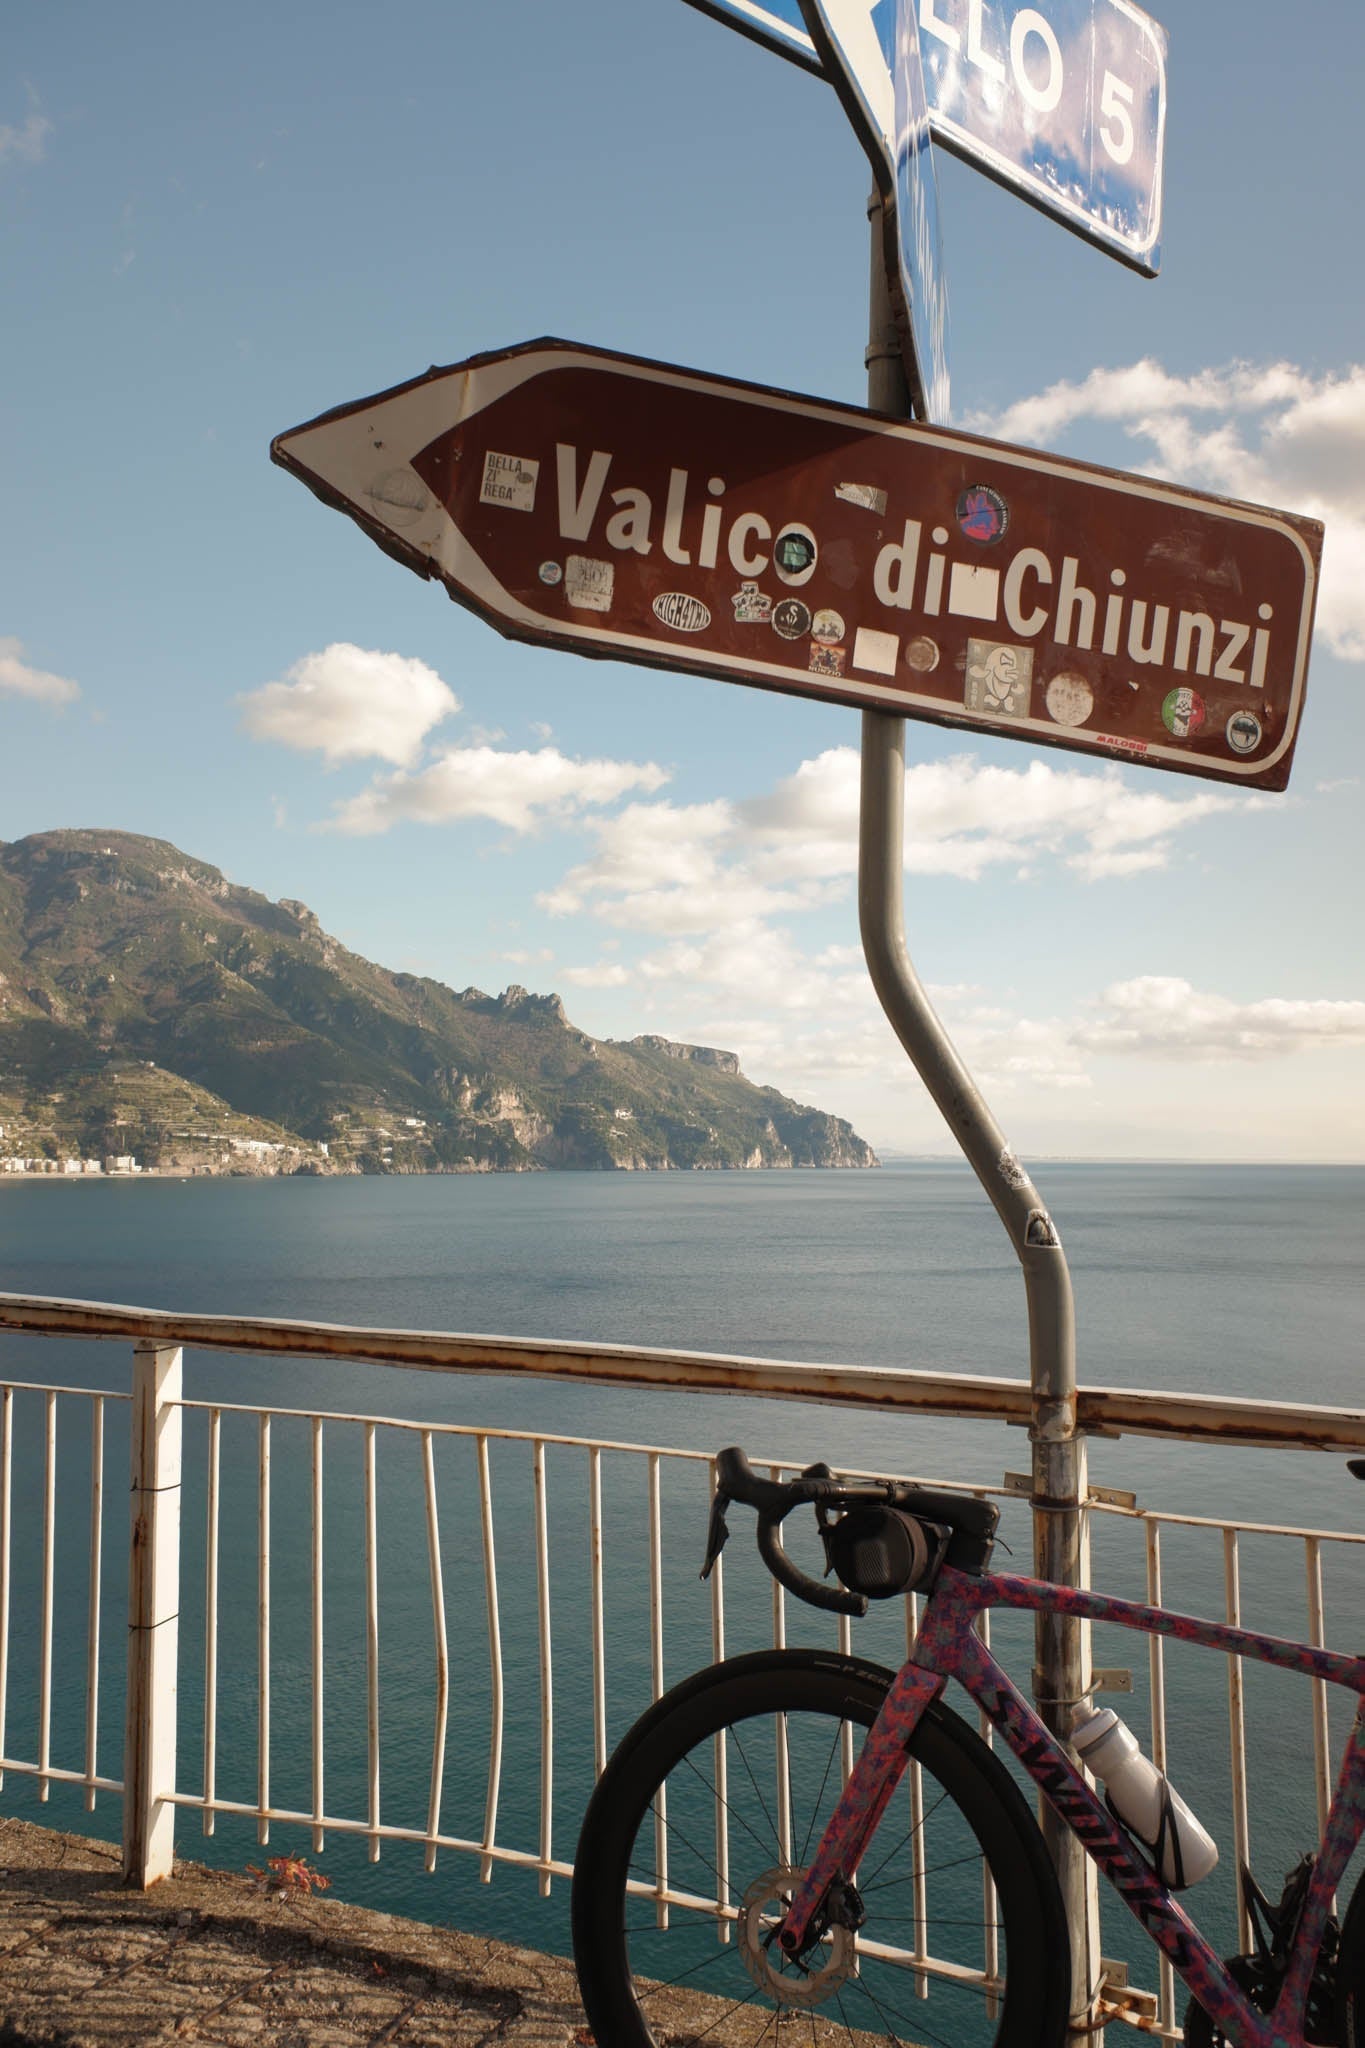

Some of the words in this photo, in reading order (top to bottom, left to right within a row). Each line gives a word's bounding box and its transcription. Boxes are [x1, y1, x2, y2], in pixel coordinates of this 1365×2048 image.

[1100, 70, 1134, 165] 5
[488, 454, 522, 473] BELLA
[555, 442, 817, 586] Valico
[873, 520, 948, 616] di
[1004, 547, 1273, 688] Chiunzi
[976, 1690, 1195, 1968] S-WORKS
